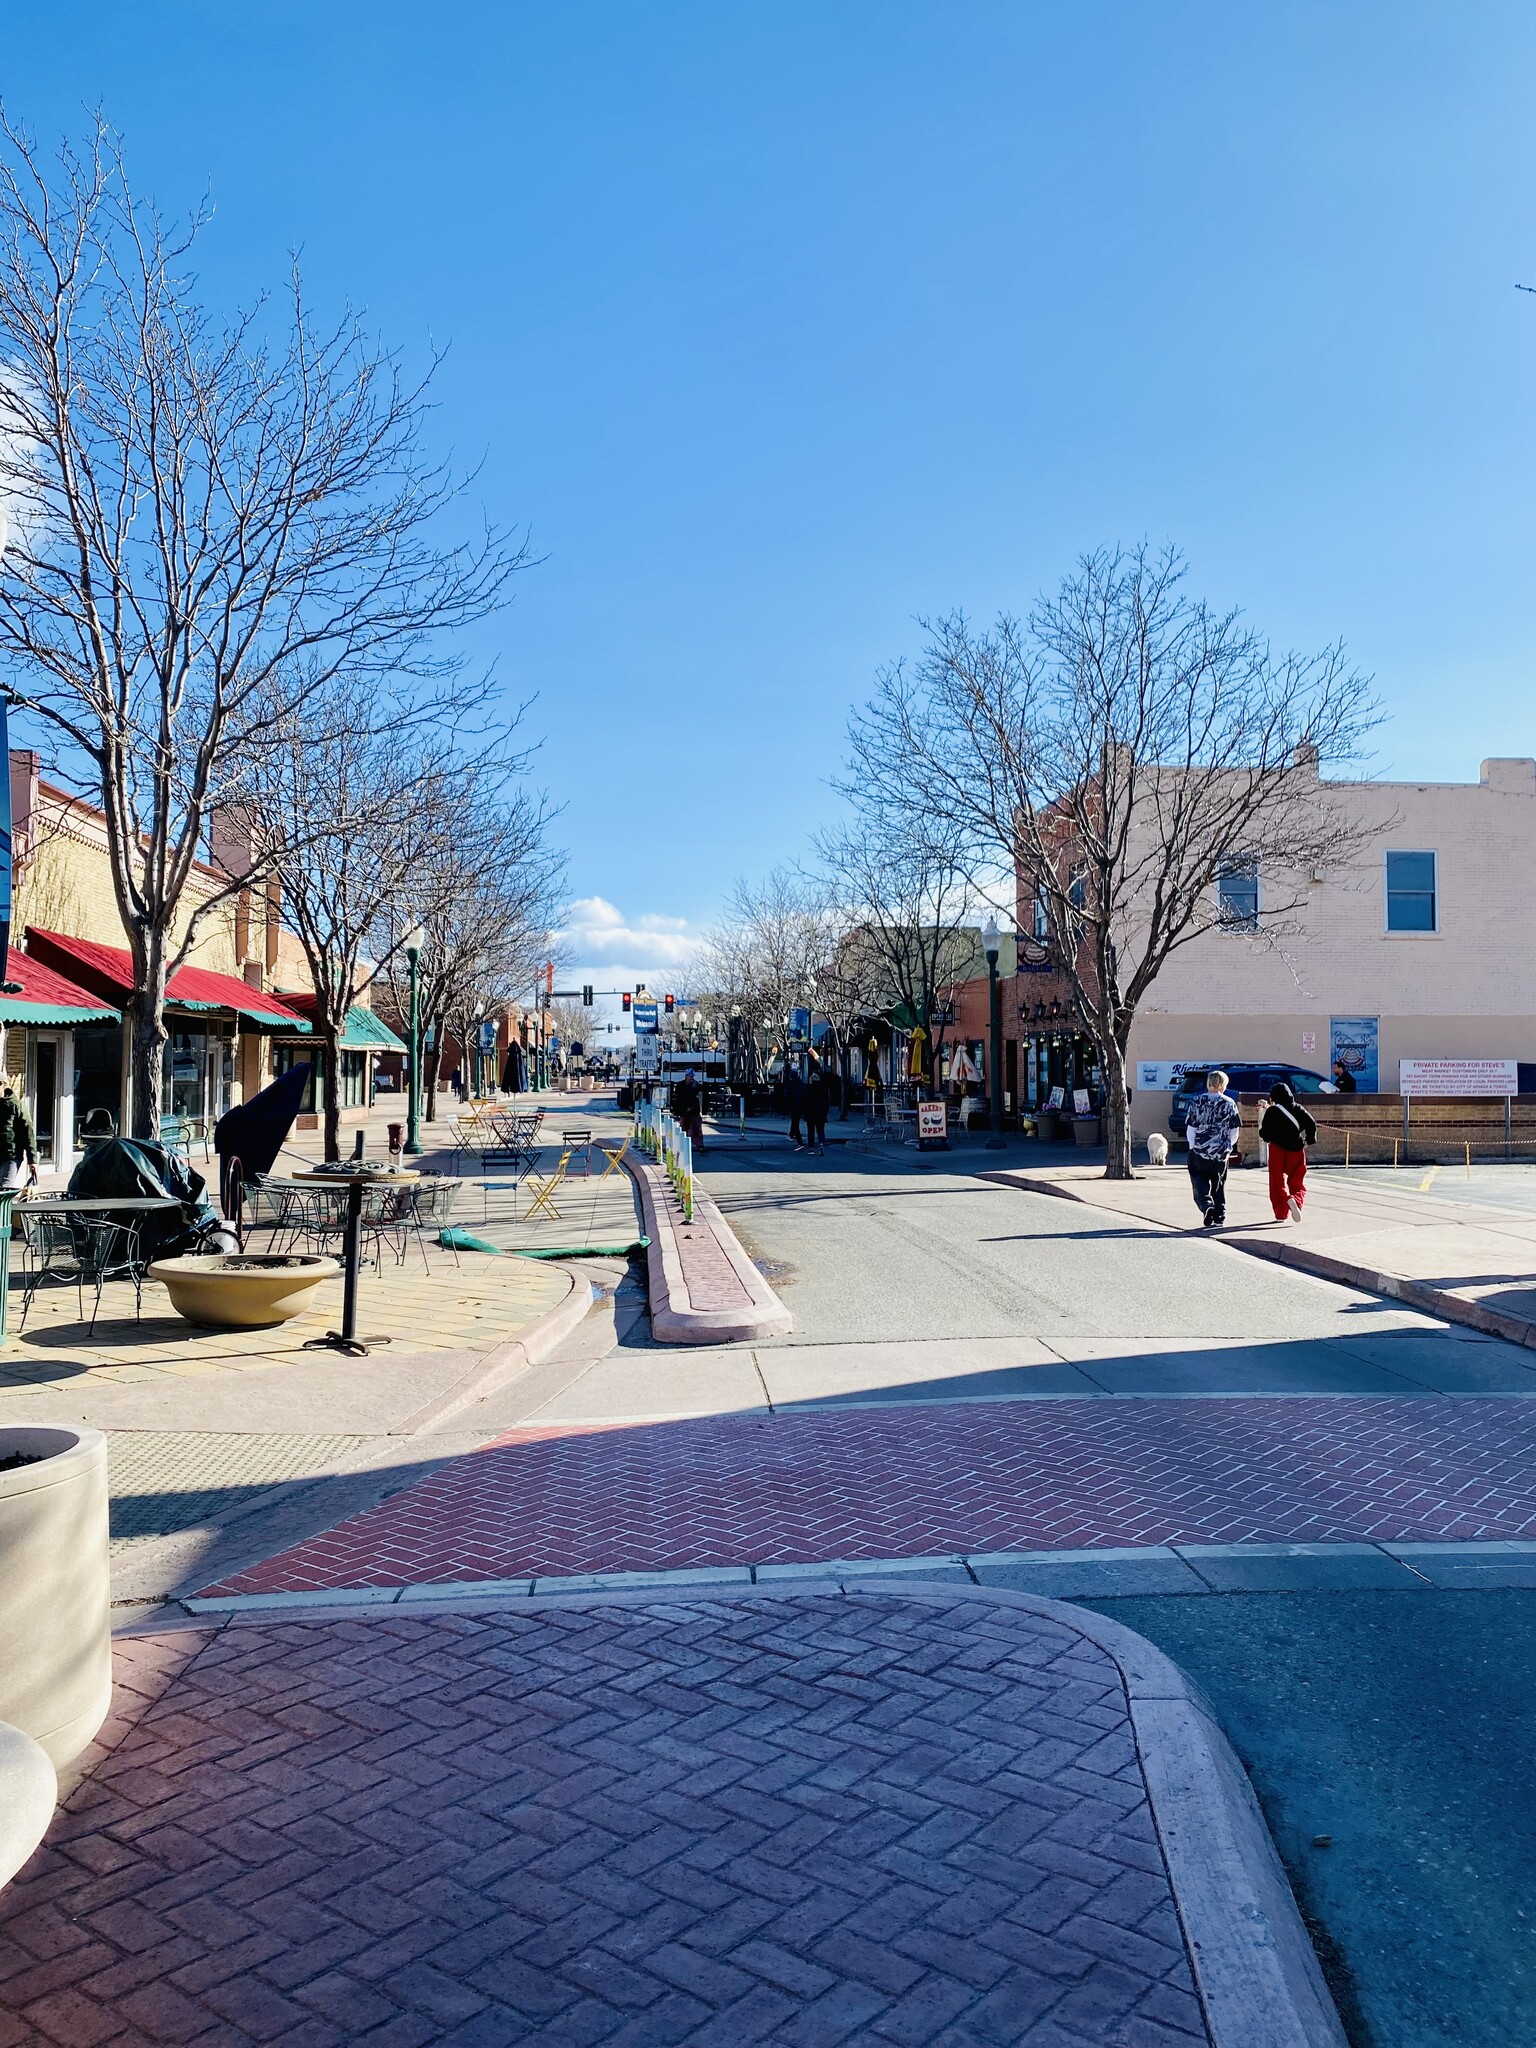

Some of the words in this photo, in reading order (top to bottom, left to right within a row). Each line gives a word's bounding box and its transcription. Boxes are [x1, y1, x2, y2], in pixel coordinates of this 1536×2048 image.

[636, 1020, 656, 1028] Welcome!
[642, 1048, 652, 1056] THRU
[639, 1060, 656, 1068] TRAFFIC
[920, 1104, 942, 1112] BAKERY
